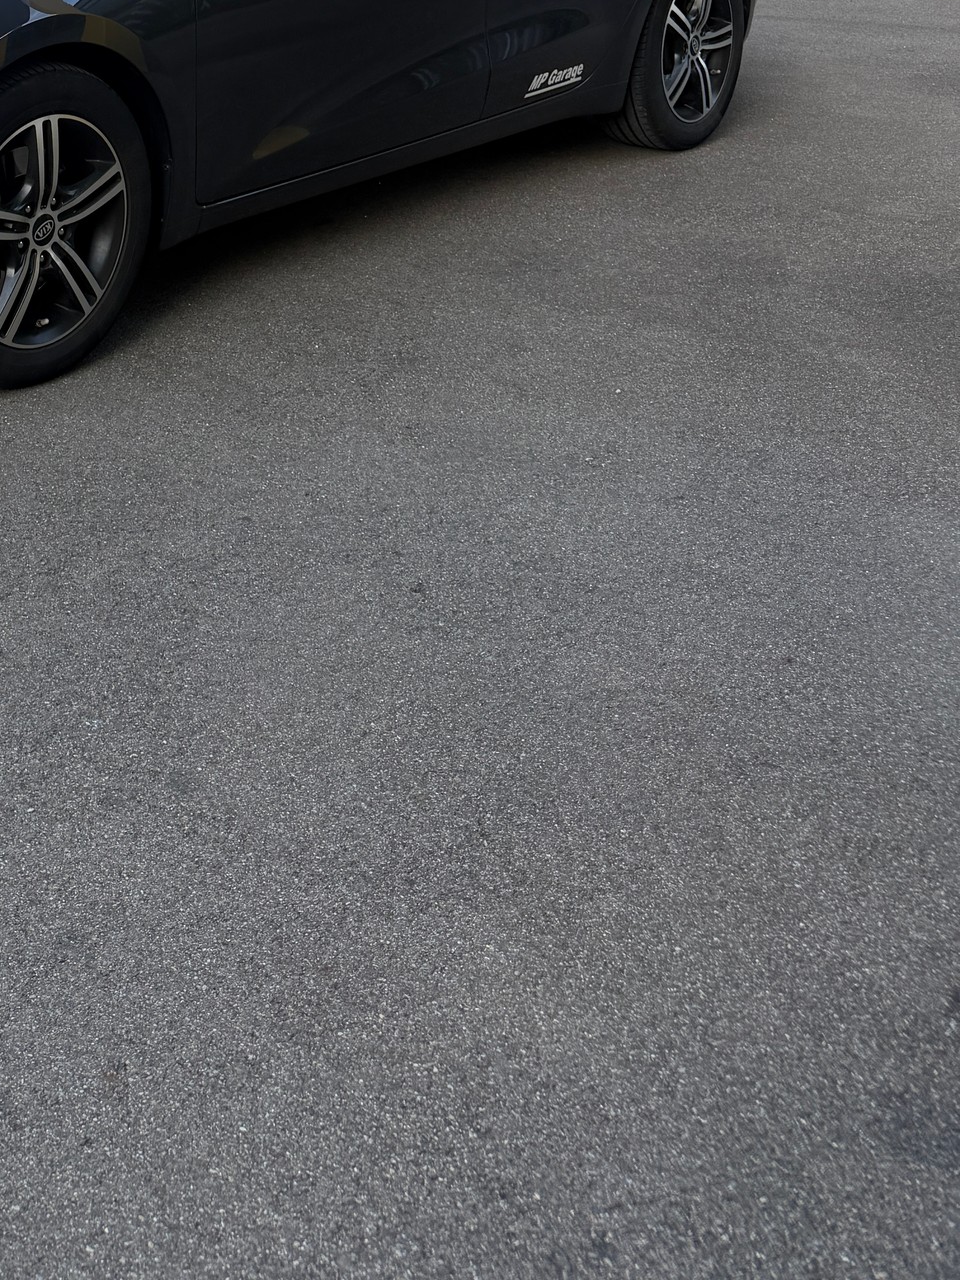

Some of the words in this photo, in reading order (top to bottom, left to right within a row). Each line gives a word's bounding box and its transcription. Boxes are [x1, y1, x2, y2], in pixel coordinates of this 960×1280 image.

[527, 72, 549, 91] MP
[547, 63, 583, 86] Garage
[37, 222, 52, 237] KIA
